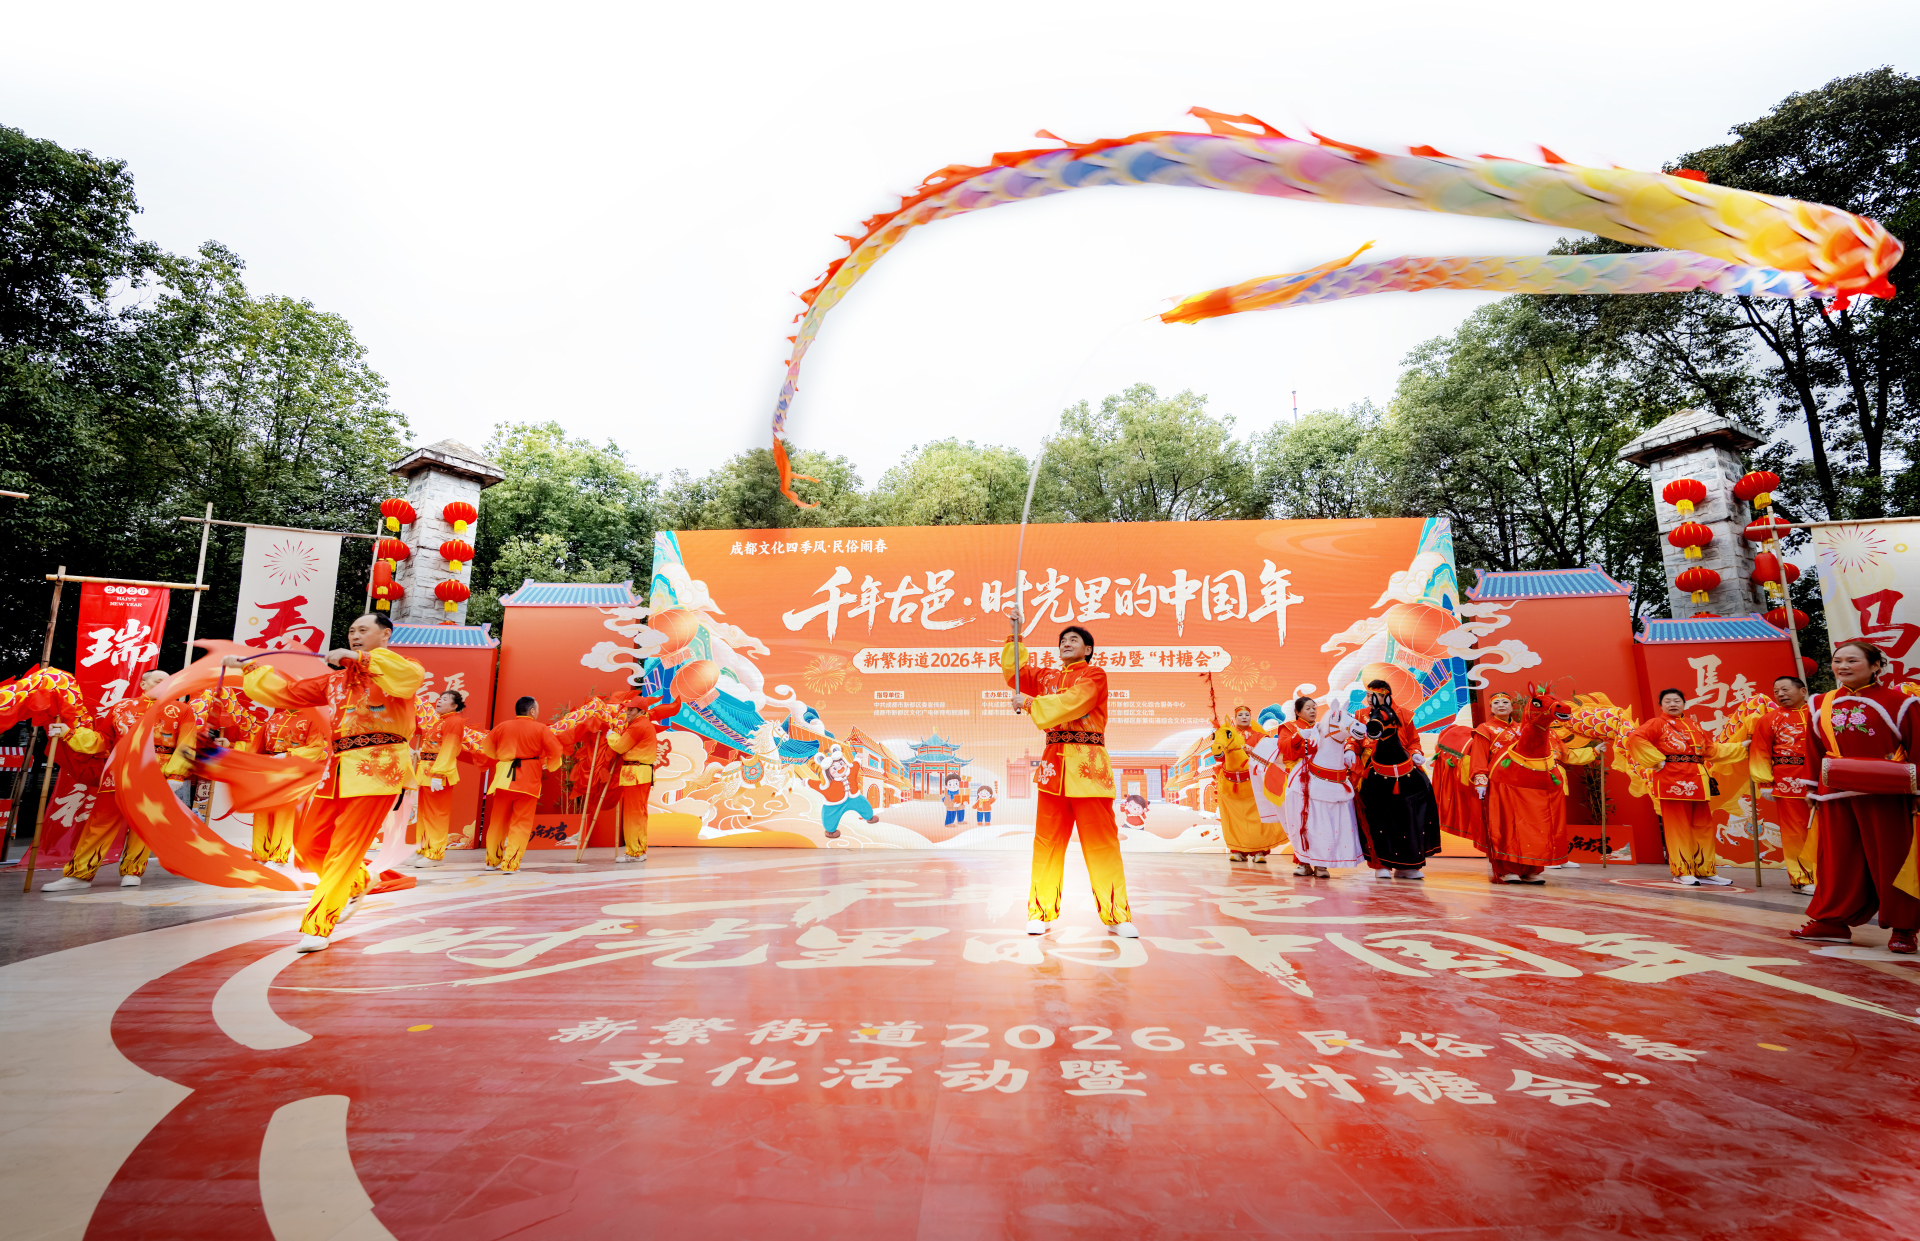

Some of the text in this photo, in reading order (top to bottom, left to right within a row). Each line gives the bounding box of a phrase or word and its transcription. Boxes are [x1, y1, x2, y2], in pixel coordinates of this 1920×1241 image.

[729, 538, 888, 556] 成都文化四季风·民俗闹春
[104, 585, 149, 596] 2026
[782, 559, 1304, 647] 千年古邑·时光里的中国年
[548, 1016, 1707, 1062] 新繁街道2026年民俗闹春
[581, 1052, 1651, 1108] 文化活动暨“村糖会”
